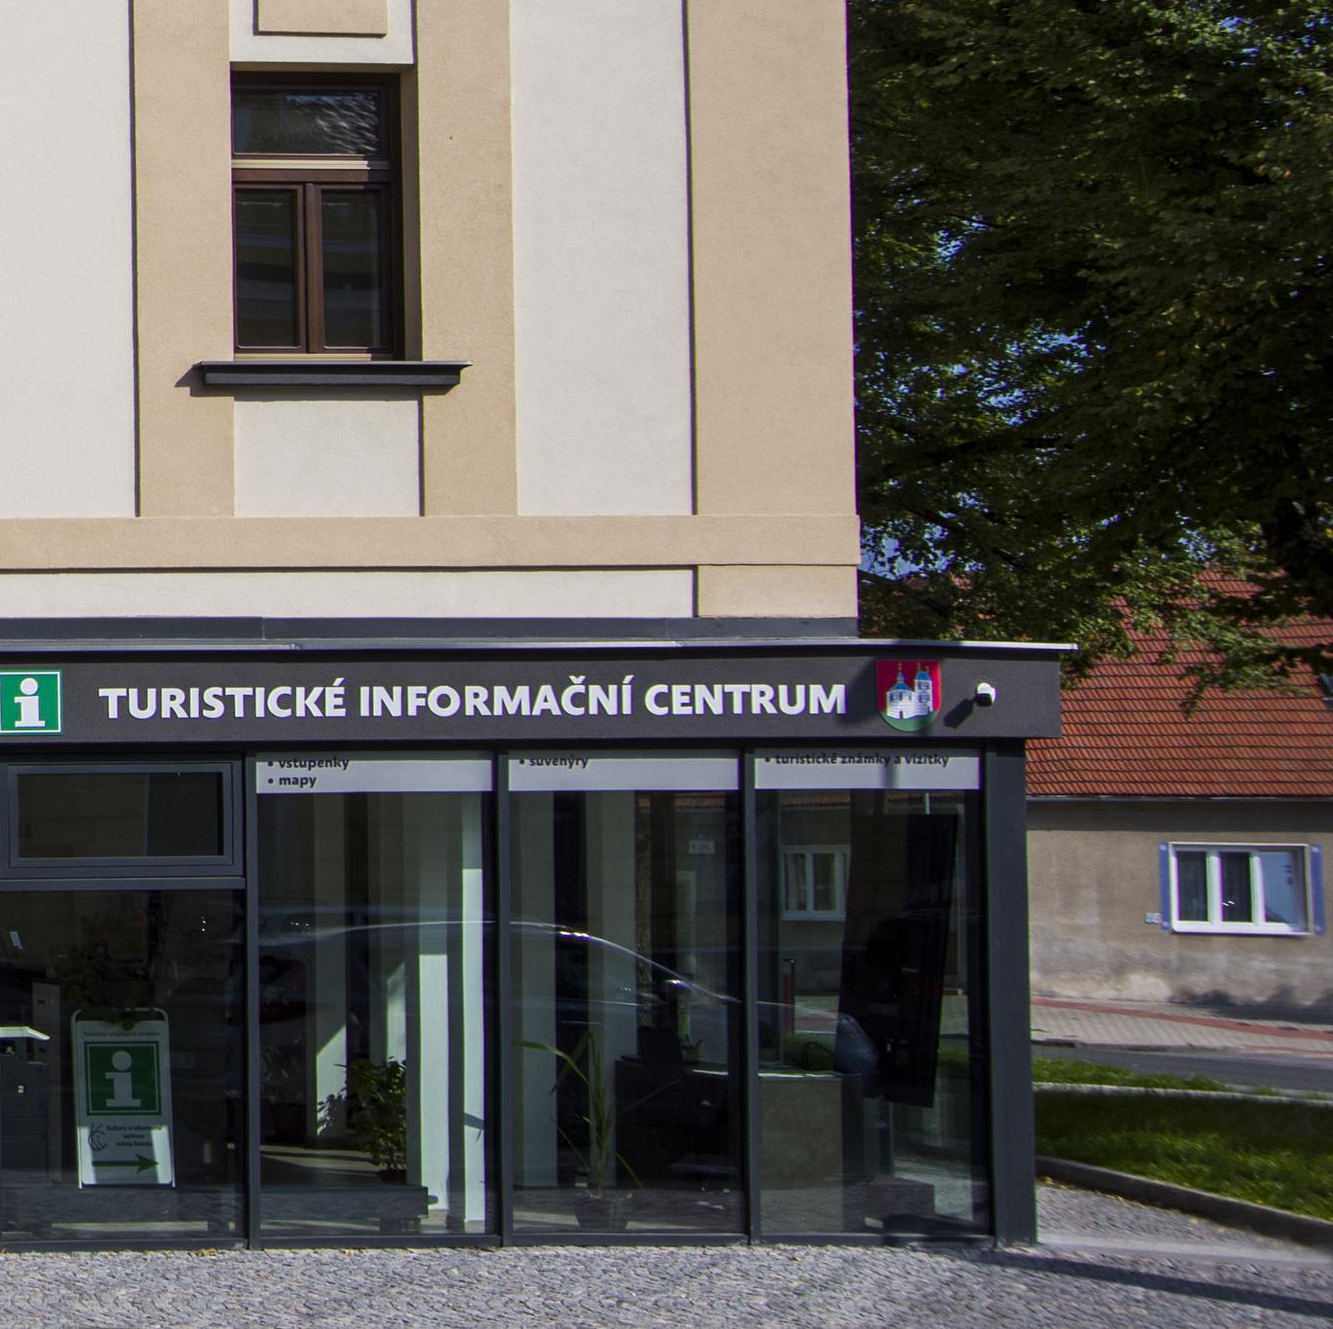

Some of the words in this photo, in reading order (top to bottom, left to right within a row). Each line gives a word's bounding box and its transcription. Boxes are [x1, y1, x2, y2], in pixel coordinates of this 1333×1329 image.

[98, 677, 348, 720] TURISTICKÉ
[359, 674, 635, 719] INFORMAČNÍ
[644, 683, 848, 717] CENTRUM
[278, 756, 350, 771] vstupenky
[529, 754, 589, 770] suvenýry
[278, 776, 317, 788] mapy
